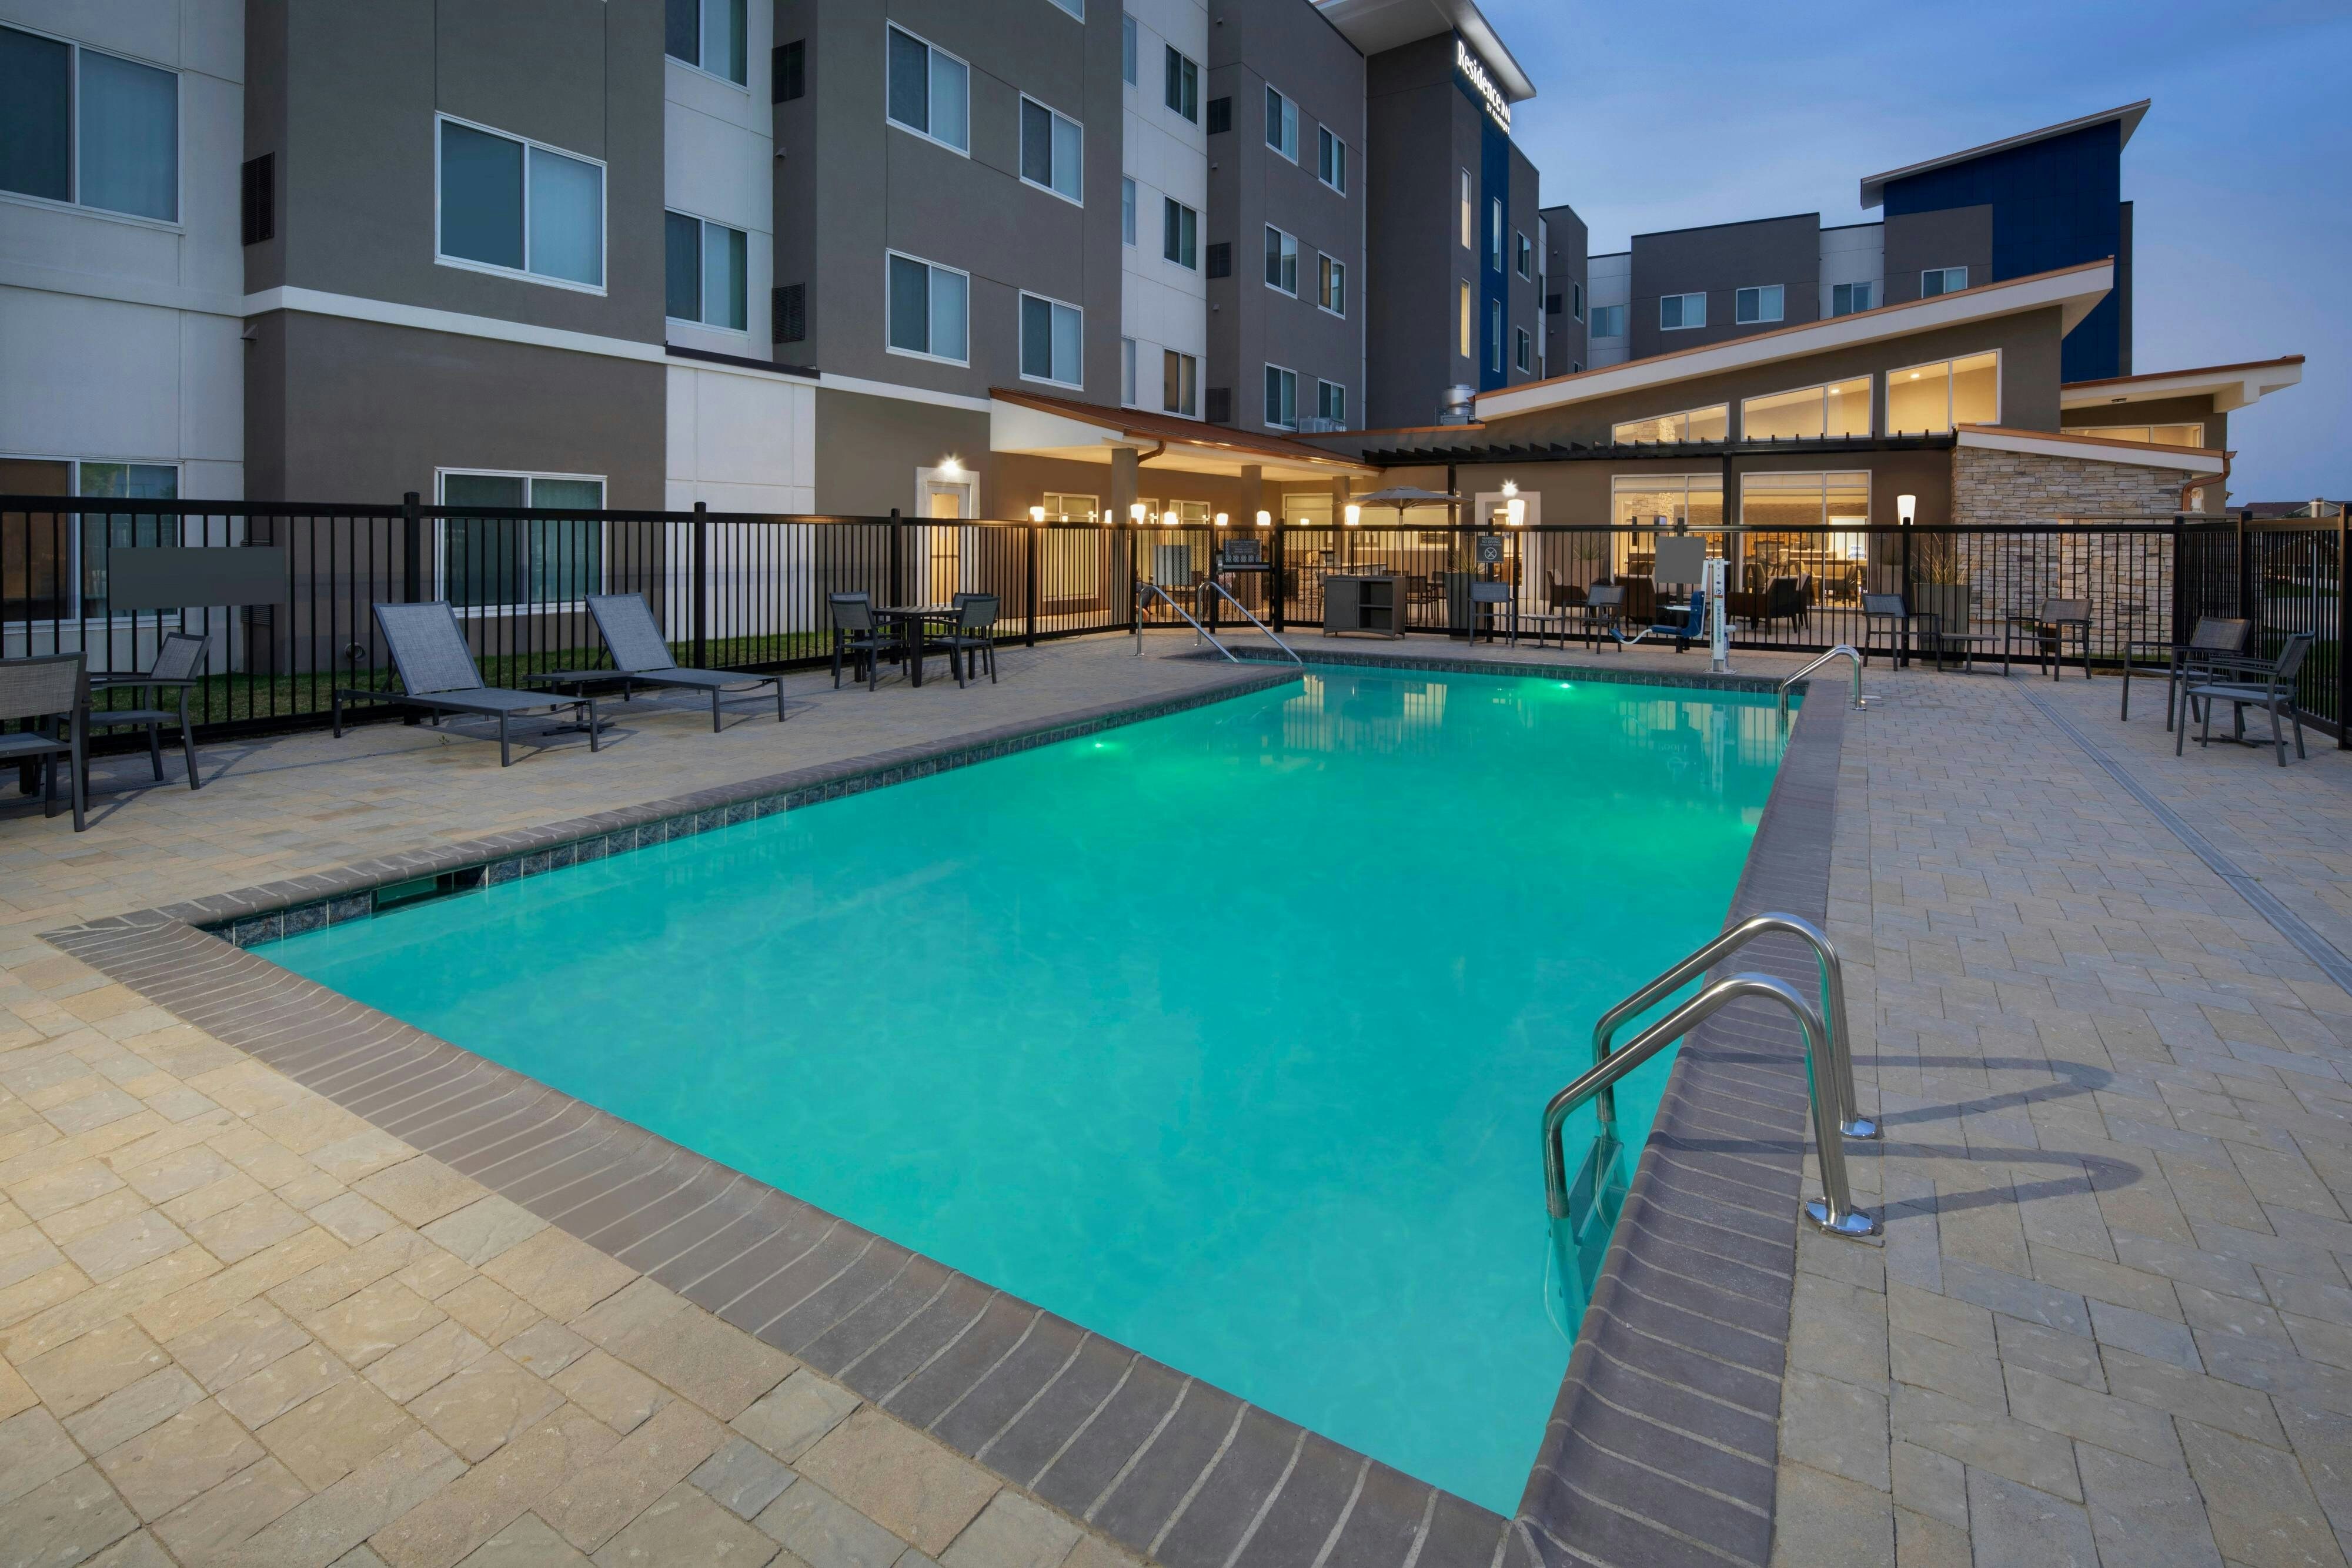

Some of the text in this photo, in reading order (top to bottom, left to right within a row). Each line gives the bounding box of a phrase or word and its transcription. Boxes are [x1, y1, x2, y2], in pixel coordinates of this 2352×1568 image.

[1458, 41, 1511, 123] Residence INN
[1486, 102, 1510, 135] BY MARRIOTT
